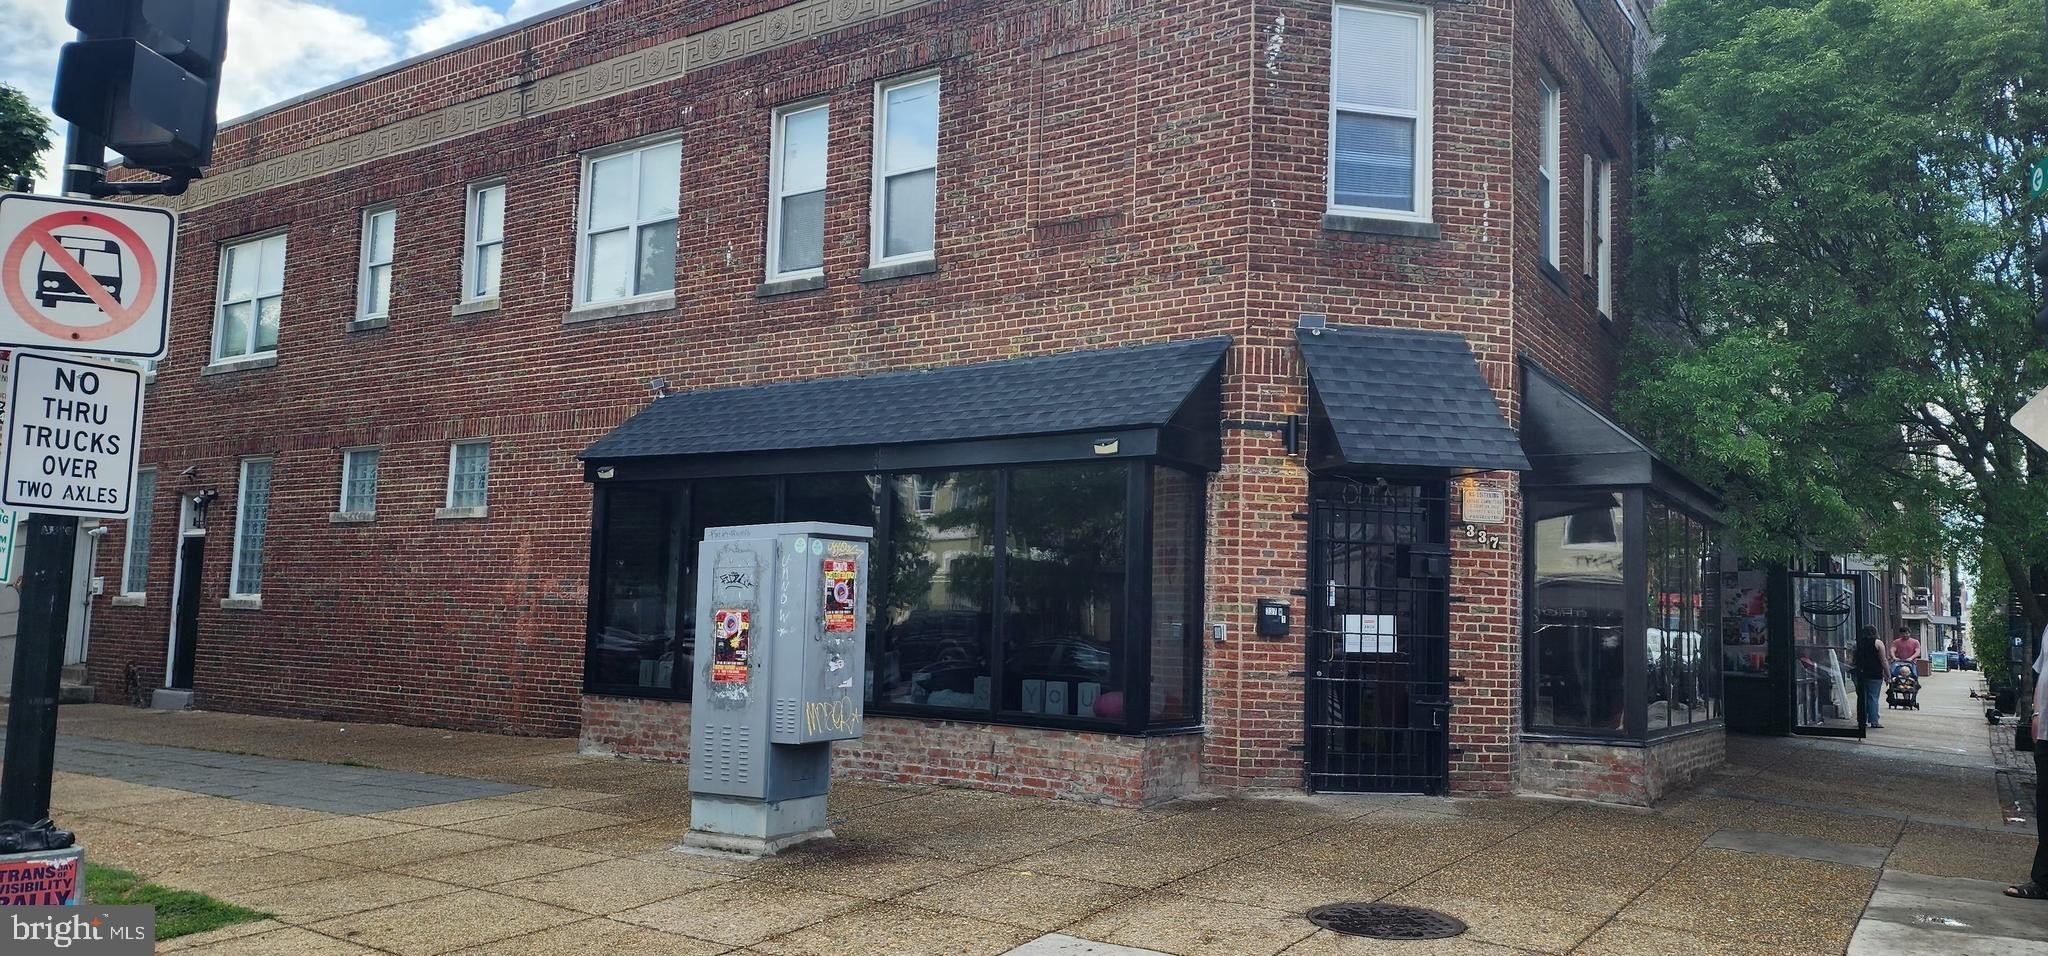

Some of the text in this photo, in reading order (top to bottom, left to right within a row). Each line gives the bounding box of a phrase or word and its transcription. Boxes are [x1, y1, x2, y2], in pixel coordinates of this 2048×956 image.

[55, 367, 100, 396] NO
[42, 397, 108, 425] THRU
[22, 425, 120, 455] TRUCKS
[42, 455, 98, 479] OVER
[17, 480, 53, 499] TWO
[62, 484, 118, 505] AXLES
[1466, 524, 1499, 549] 337
[0, 866, 56, 883] TRANS
[0, 878, 73, 893] VISIBILITY
